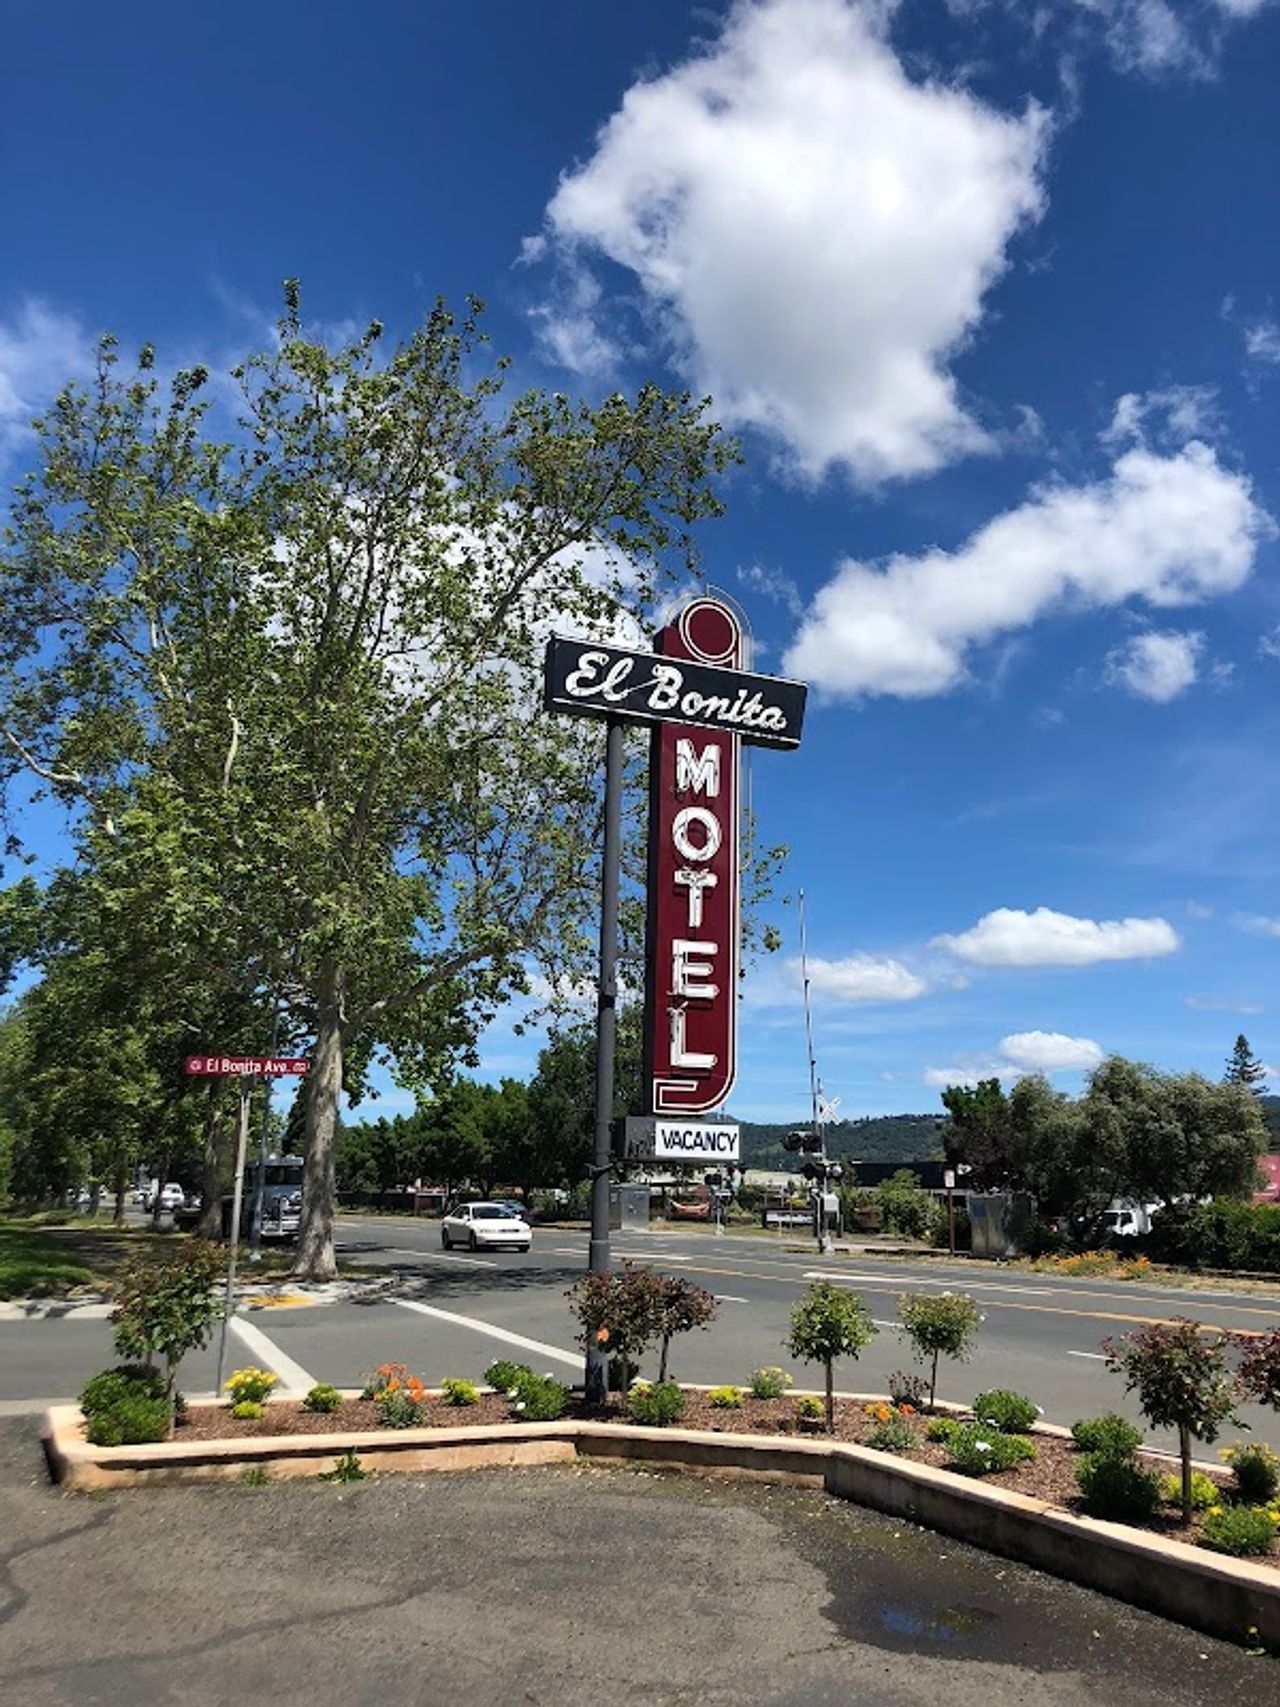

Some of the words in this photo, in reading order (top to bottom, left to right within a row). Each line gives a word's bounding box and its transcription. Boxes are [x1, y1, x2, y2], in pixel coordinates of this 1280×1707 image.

[565, 651, 638, 701] El
[647, 663, 789, 731] Bonita
[671, 738, 722, 1068] MOTEL
[206, 1058, 219, 1072] El
[221, 1059, 261, 1073] Bonita
[661, 1129, 738, 1152] VACANCY
